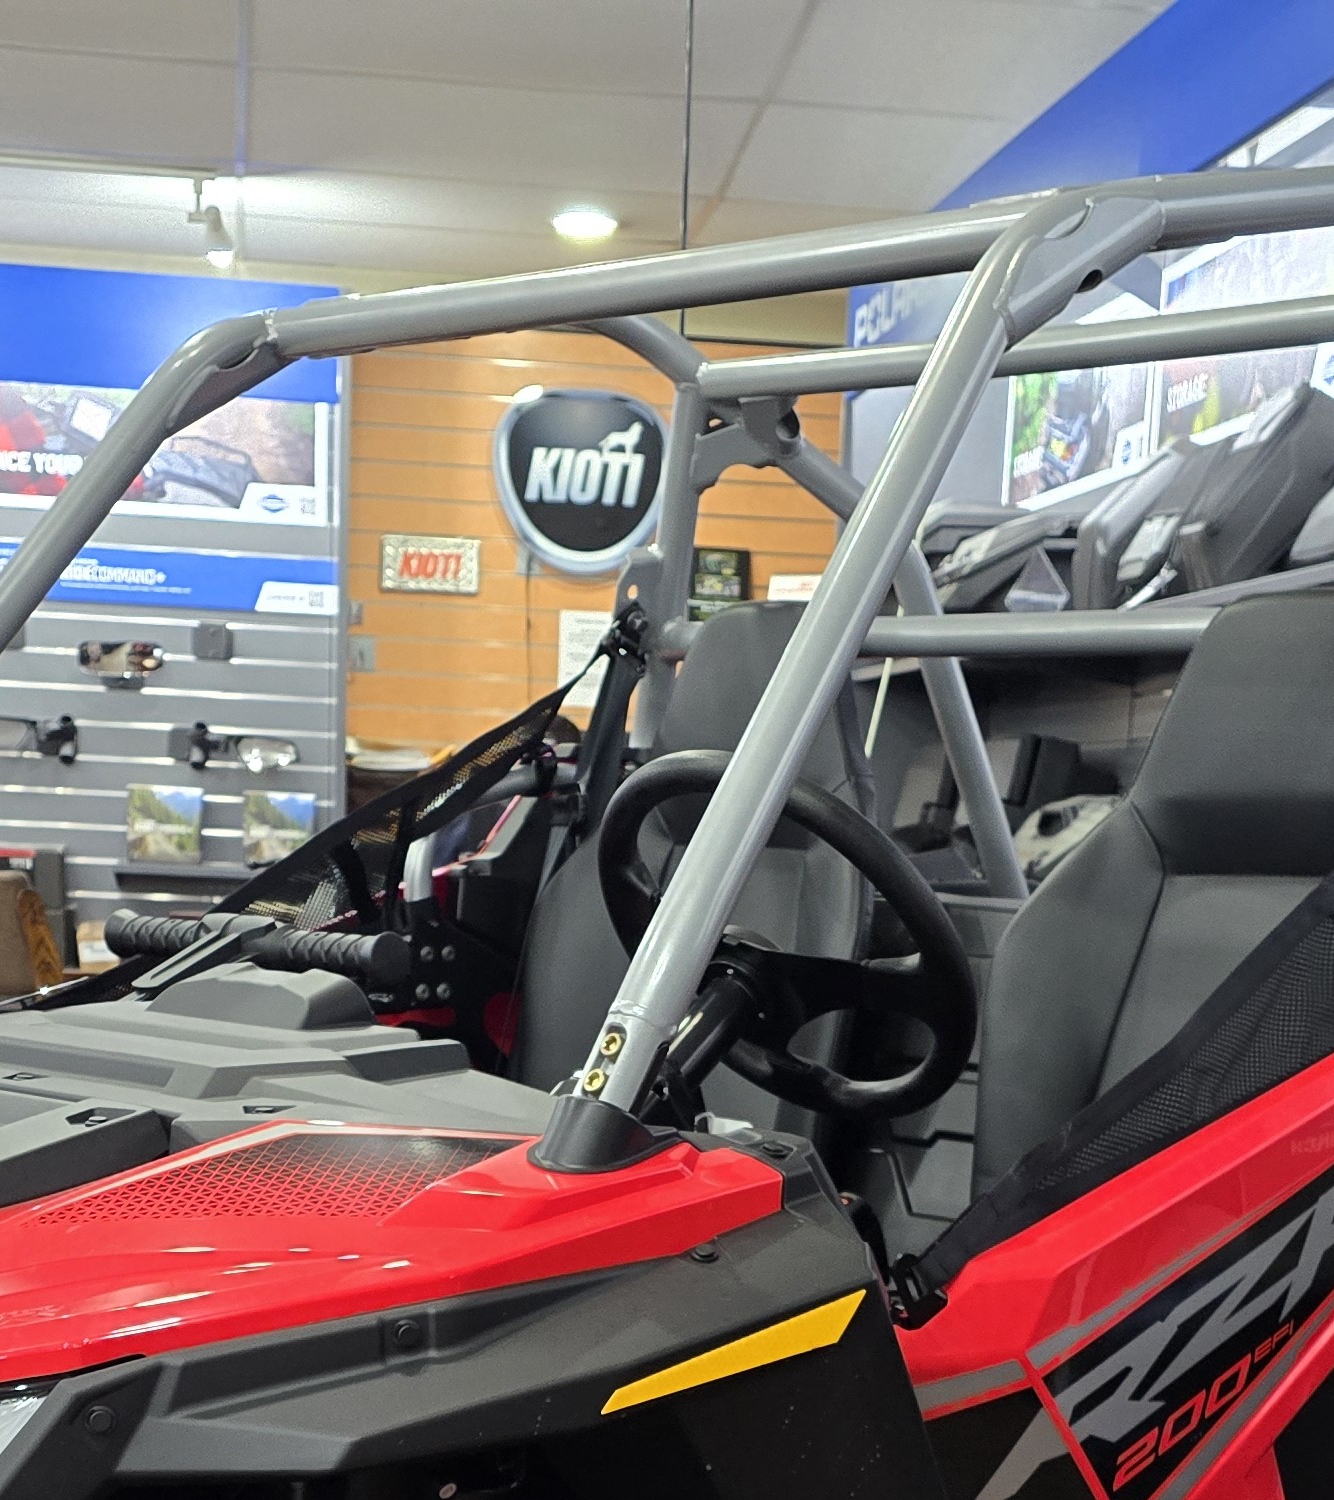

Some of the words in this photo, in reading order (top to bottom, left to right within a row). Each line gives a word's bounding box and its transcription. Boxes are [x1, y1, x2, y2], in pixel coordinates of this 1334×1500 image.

[523, 446, 646, 509] KIOTI
[398, 549, 463, 581] KIOTI
[1112, 1352, 1252, 1493] 200
[1253, 1318, 1295, 1364] EFI
